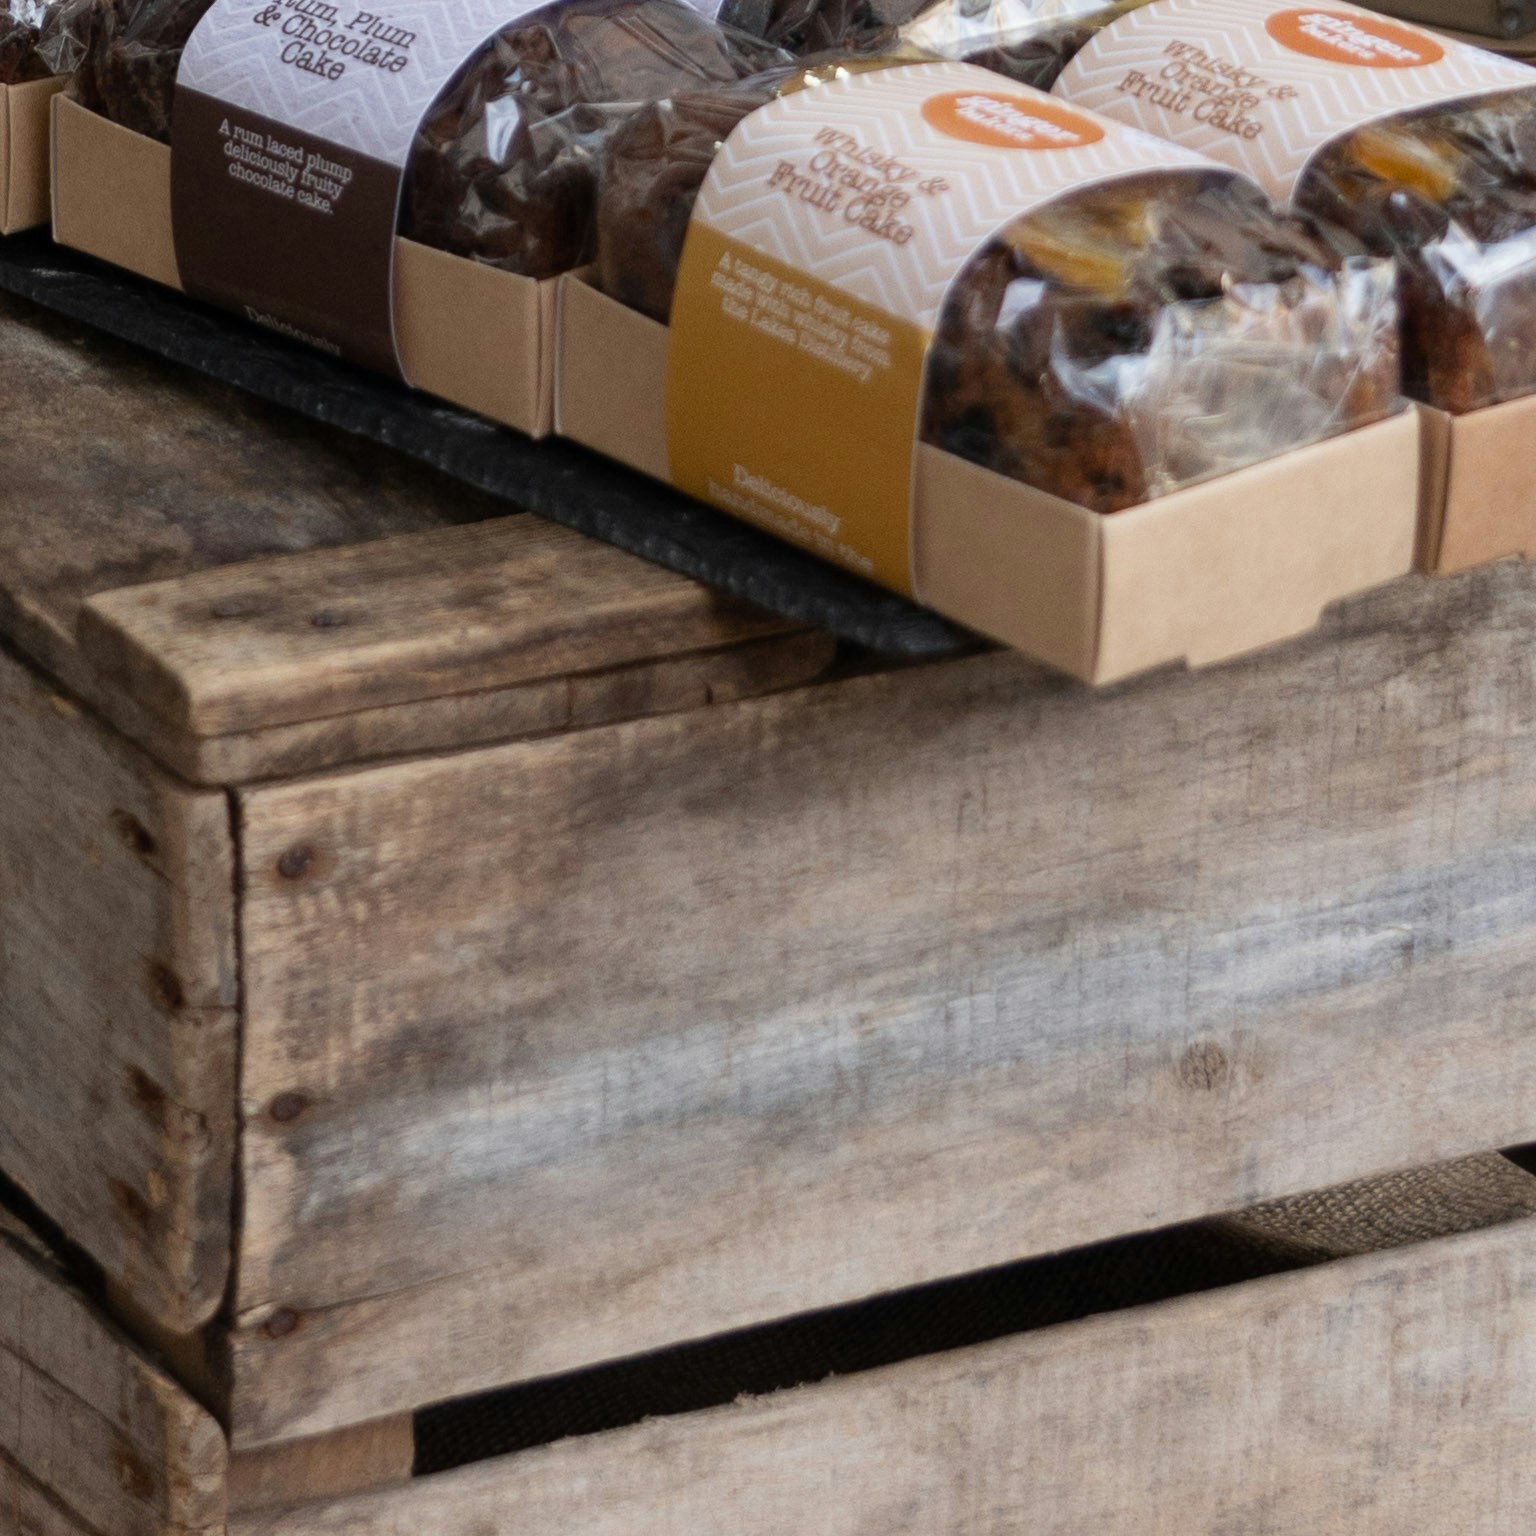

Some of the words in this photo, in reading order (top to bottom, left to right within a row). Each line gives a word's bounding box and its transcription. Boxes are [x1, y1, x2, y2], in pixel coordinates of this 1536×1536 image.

[253, 6, 283, 28] &
[281, 13, 409, 74] Chocolate
[280, 39, 346, 81] Cake
[344, 11, 416, 50] Plum
[1159, 61, 1260, 110] Orange
[1164, 39, 1265, 90] Whisky
[1266, 82, 1297, 103] &
[1116, 70, 1188, 113] Fruit
[1193, 99, 1263, 141] Cake
[218, 118, 231, 136] A
[233, 125, 264, 148] rum
[266, 135, 304, 164] laced
[307, 152, 354, 185] plump
[223, 140, 300, 182] deliciously
[300, 169, 344, 200] fruity
[809, 150, 911, 209] Orange
[814, 127, 917, 184] Whisky
[916, 174, 951, 197] &
[228, 162, 294, 199] chocolate
[297, 188, 334, 216] cake.
[766, 159, 837, 215] Fruit
[845, 197, 915, 247] Cake
